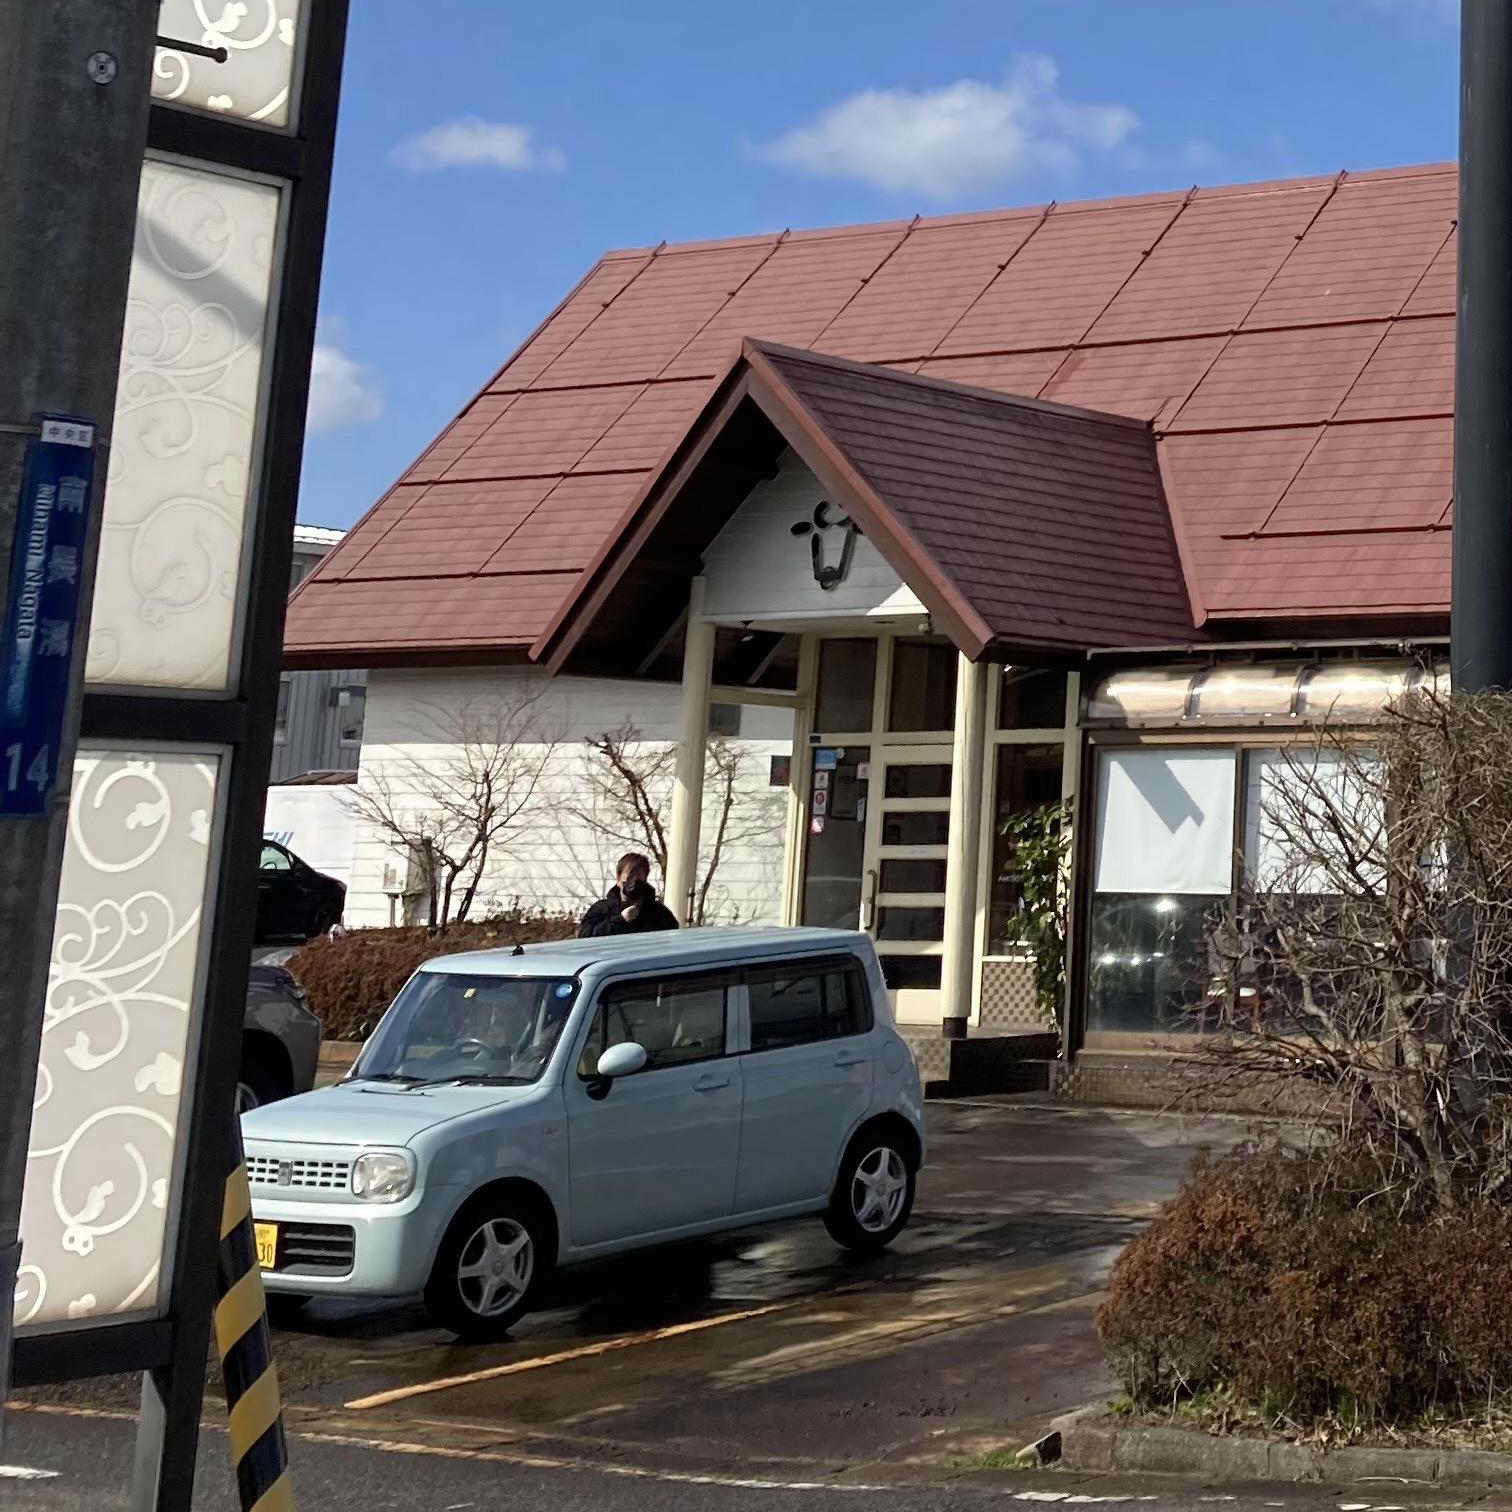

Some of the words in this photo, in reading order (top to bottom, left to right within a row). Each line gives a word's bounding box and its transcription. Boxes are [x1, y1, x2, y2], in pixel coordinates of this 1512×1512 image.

[48, 426, 89, 443] 中央区
[5, 741, 49, 793] 14
